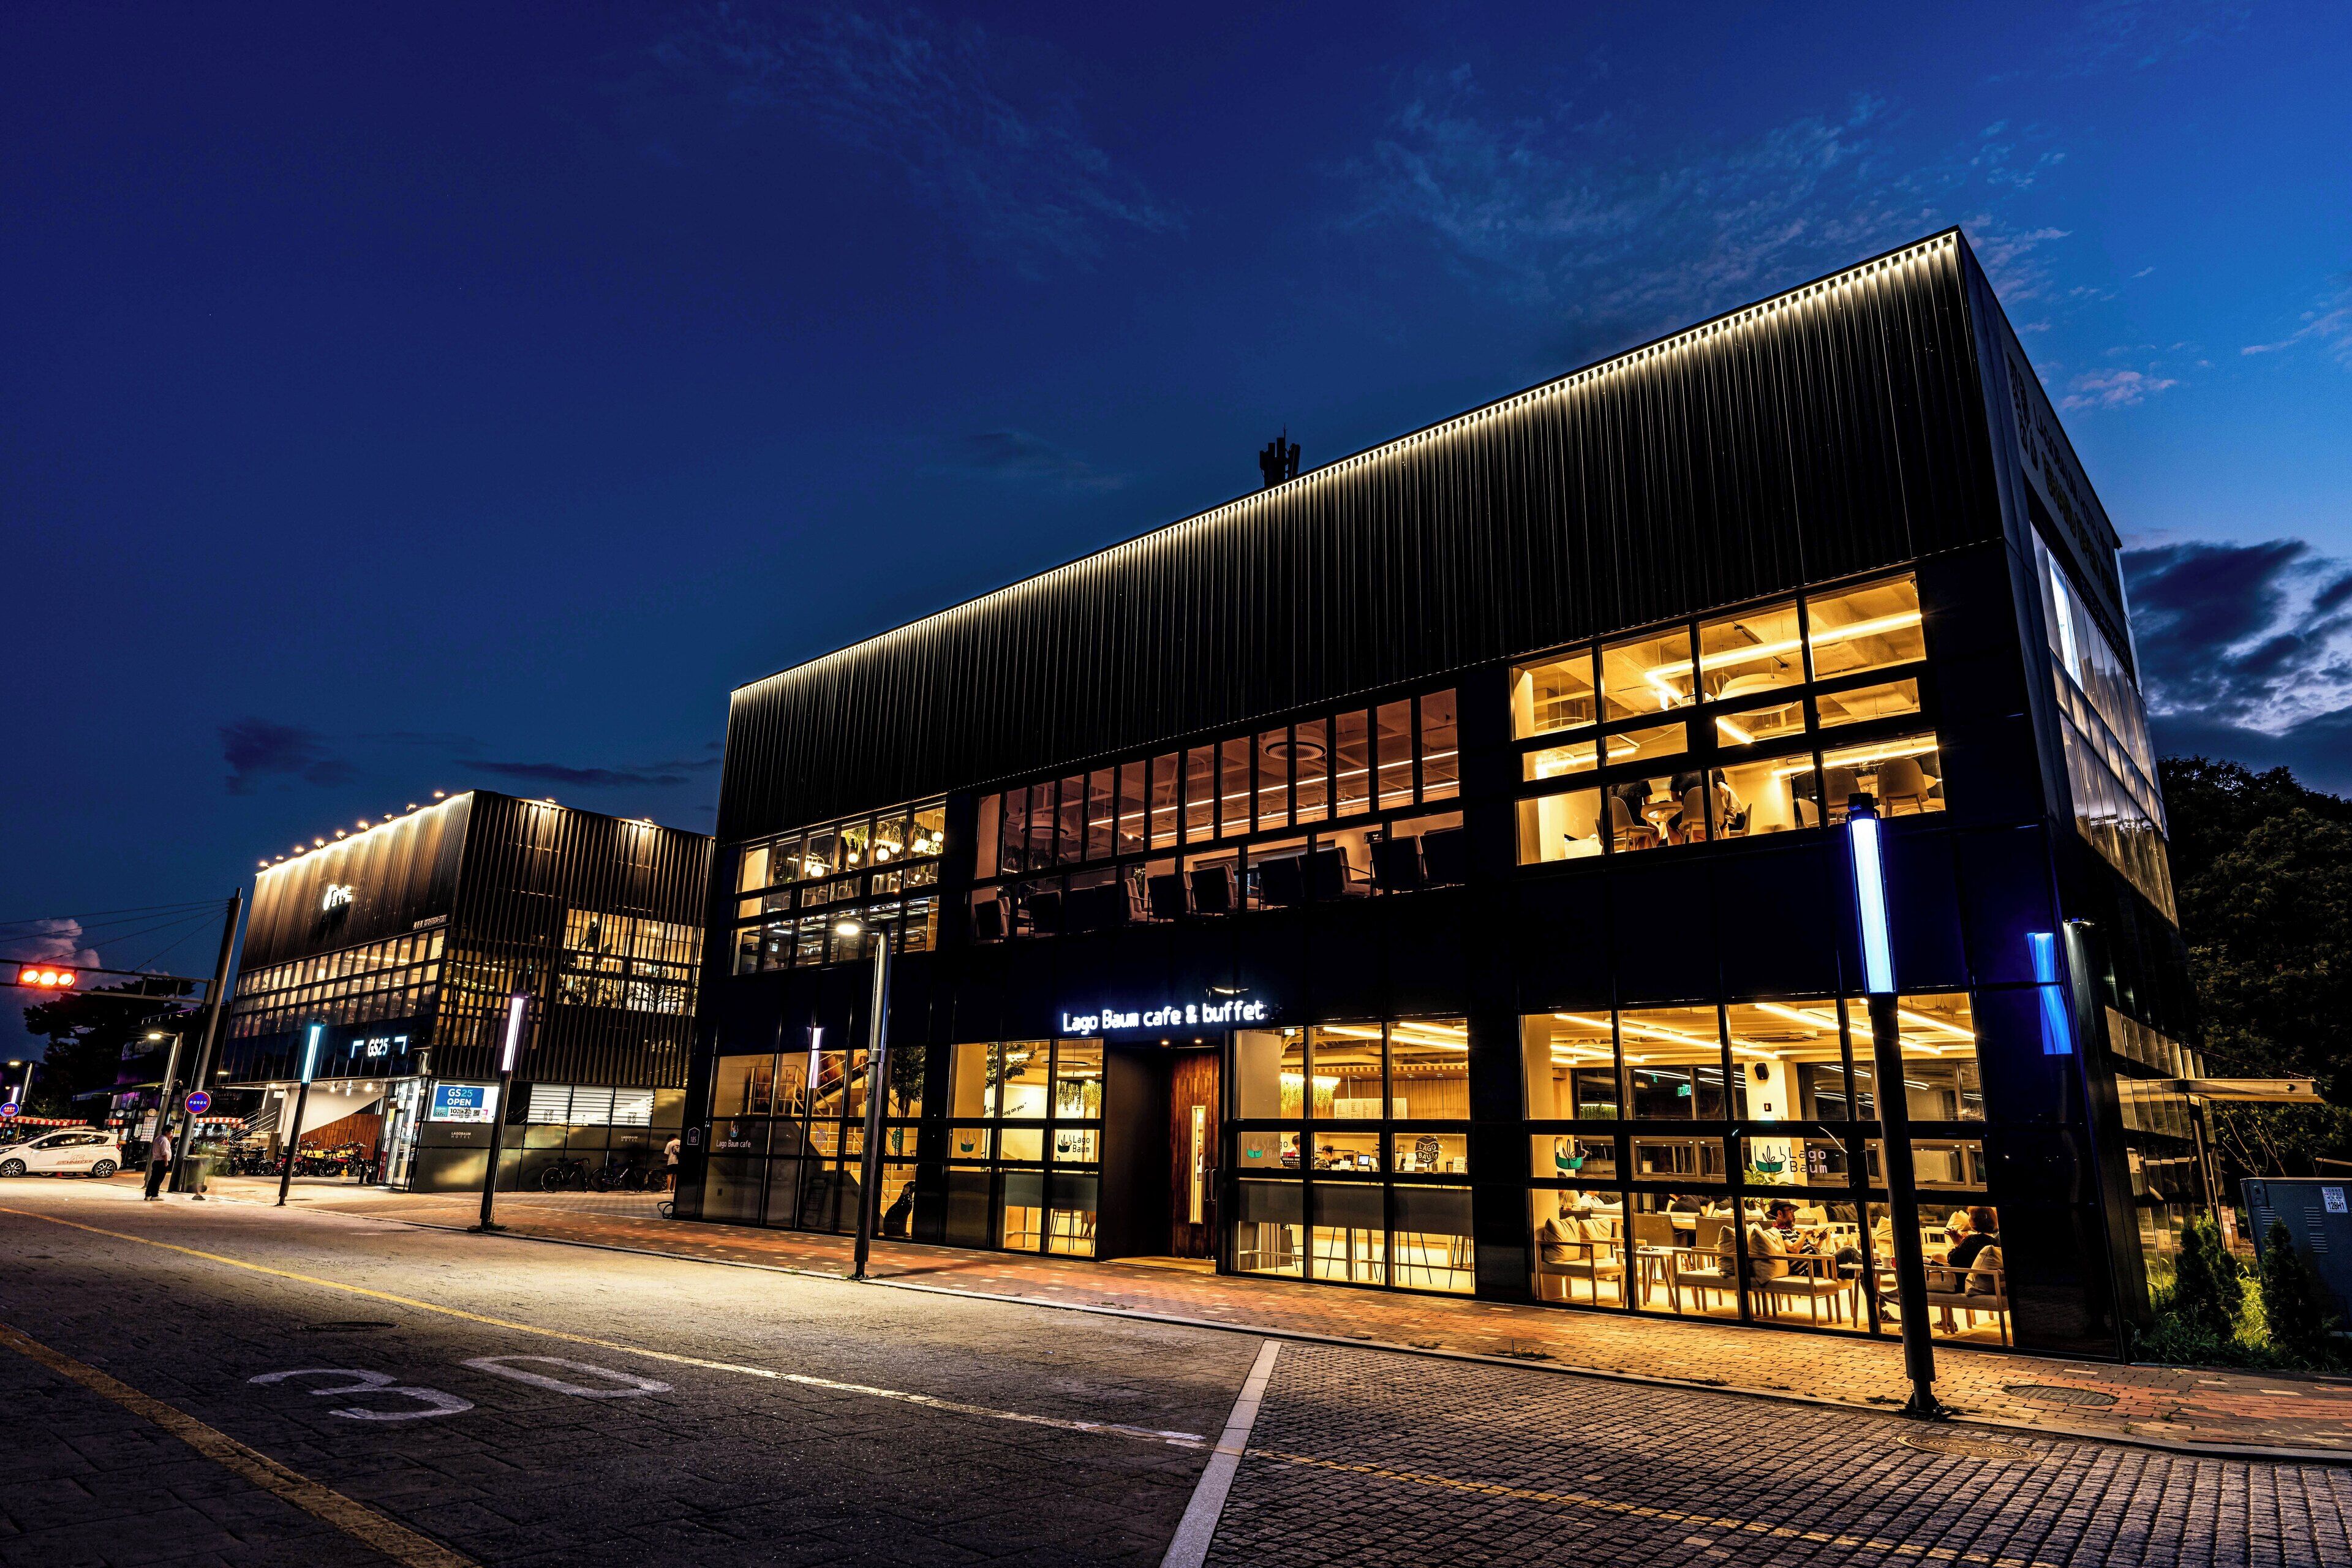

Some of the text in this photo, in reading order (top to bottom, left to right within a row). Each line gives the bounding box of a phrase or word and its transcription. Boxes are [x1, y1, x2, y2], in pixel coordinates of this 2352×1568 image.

[1063, 1000, 1266, 1035] Lago Baum cafe & buffet
[368, 1038, 390, 1057] GS25
[448, 1088, 473, 1098] GS25
[716, 1139, 727, 1148] Lago
[1073, 1135, 1090, 1145] Lago
[1419, 1143, 1436, 1152] LAGO
[1418, 1152, 1438, 1160] BAUM
[1789, 1147, 1826, 1162] Lago
[1790, 1161, 1828, 1174] Baum
[247, 1355, 674, 1420] 30
